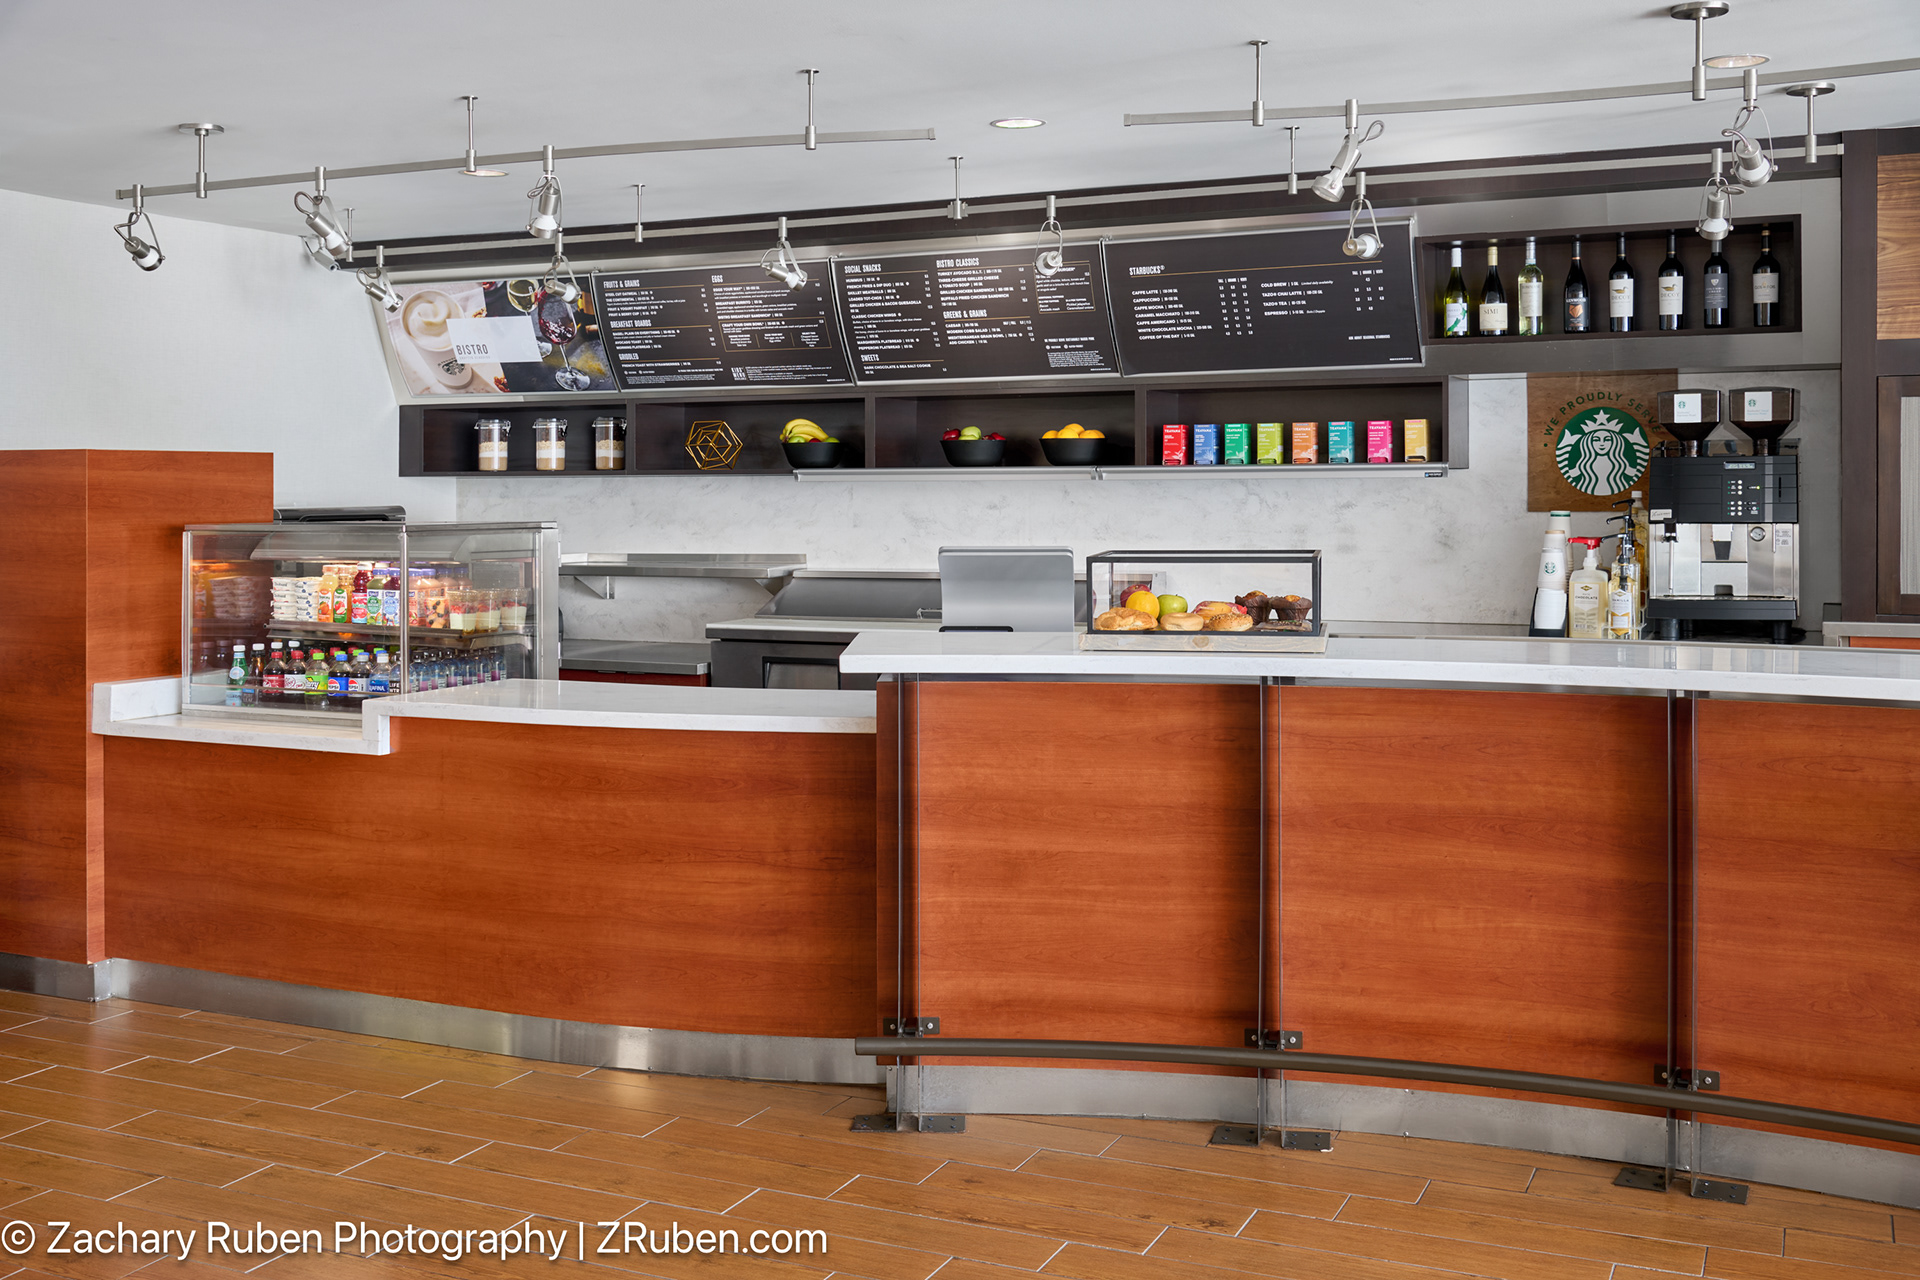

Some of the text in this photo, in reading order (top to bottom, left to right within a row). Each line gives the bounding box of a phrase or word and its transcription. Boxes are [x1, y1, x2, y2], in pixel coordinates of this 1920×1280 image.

[936, 258, 979, 268] BISTRO CLASSICS
[844, 264, 881, 274] SOCIAL SNACKS
[604, 280, 618, 288] FRUITS
[624, 280, 640, 288] GRAINS
[943, 310, 962, 319] GREENS
[969, 309, 987, 318] GRAINS
[610, 320, 633, 328] BREAKFAST
[456, 344, 488, 355] BISTRO
[1544, 392, 1662, 437] WE PROUDLY SERVE
